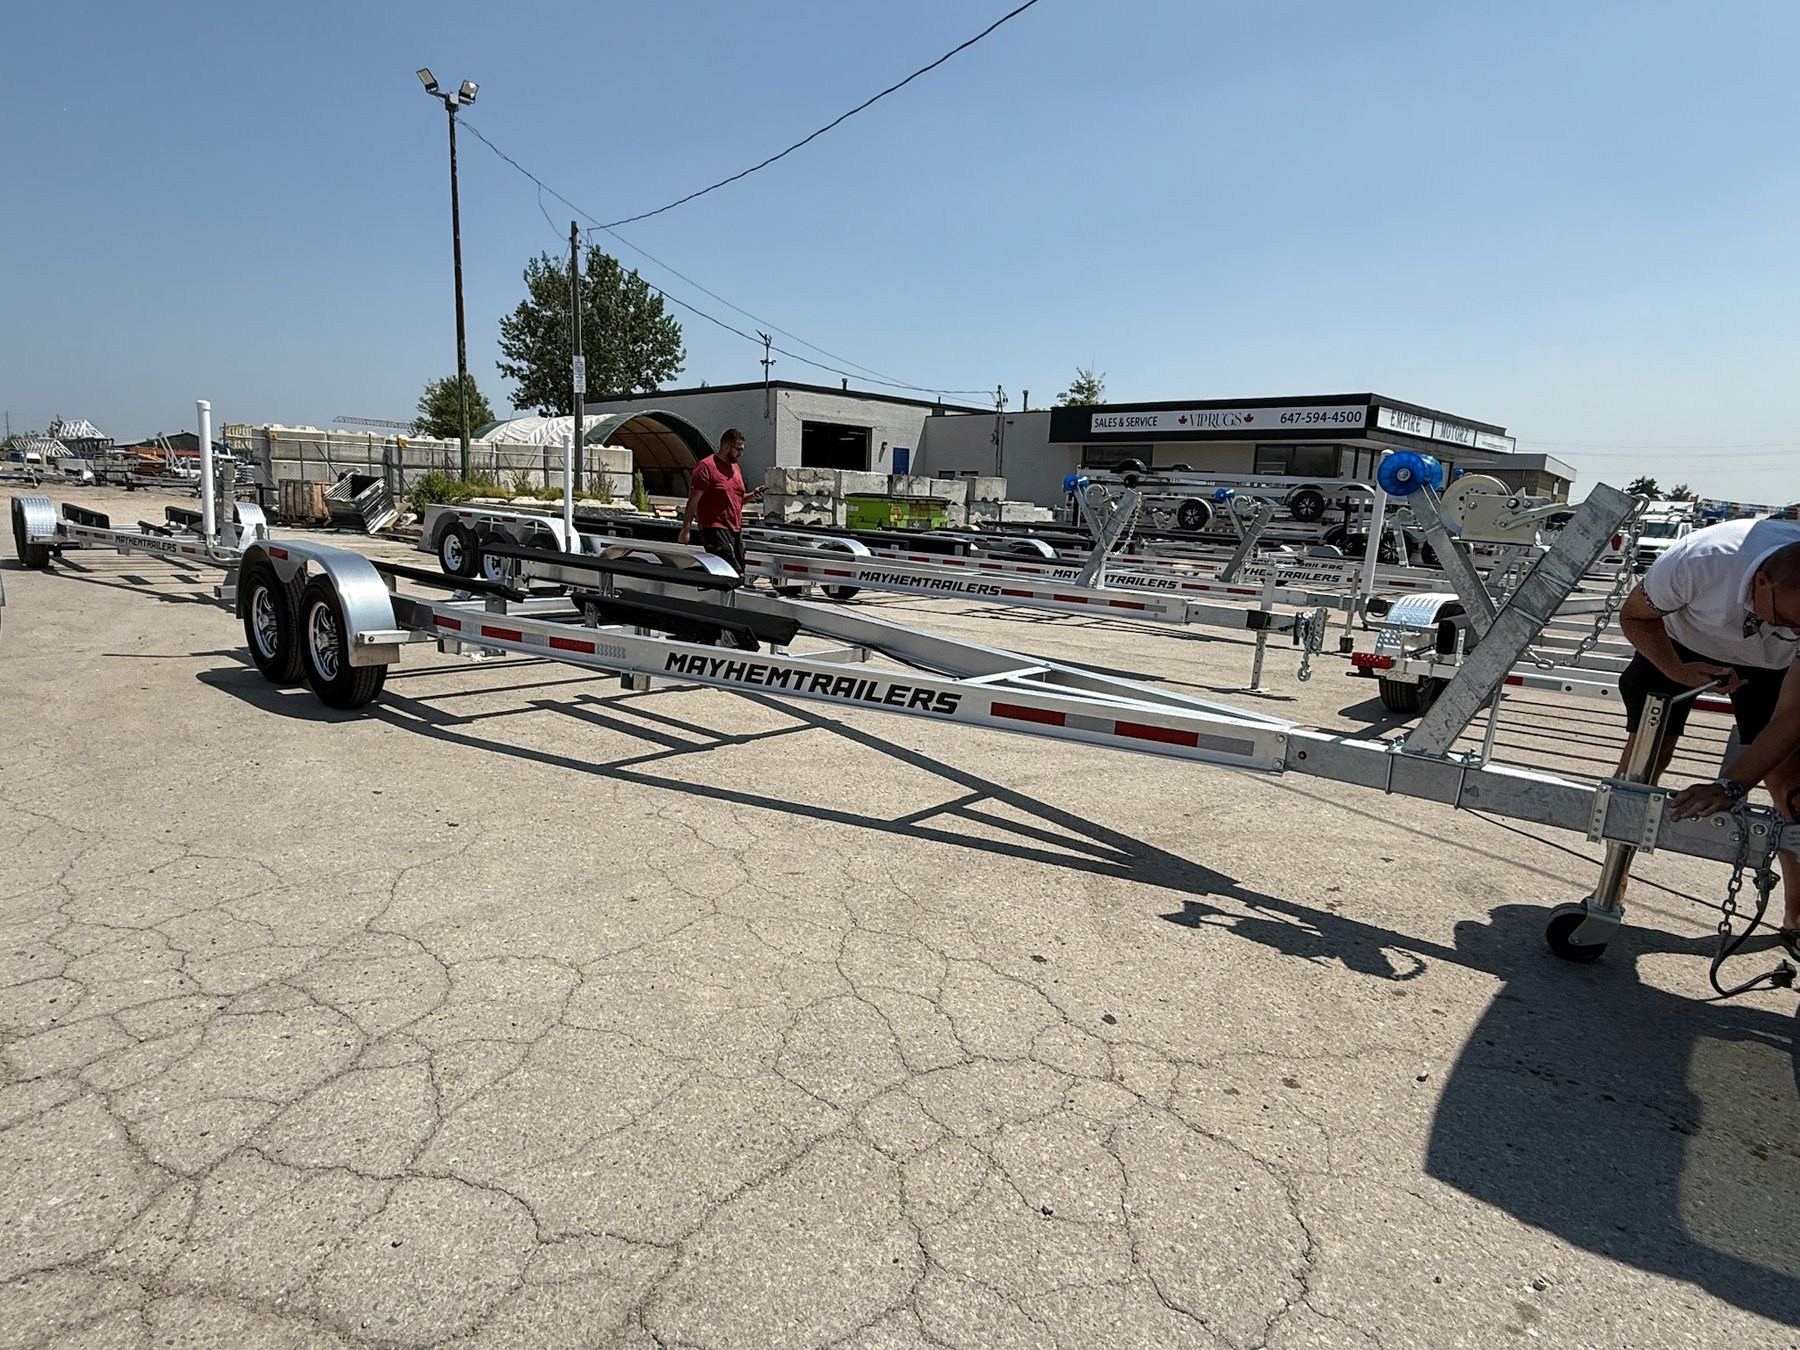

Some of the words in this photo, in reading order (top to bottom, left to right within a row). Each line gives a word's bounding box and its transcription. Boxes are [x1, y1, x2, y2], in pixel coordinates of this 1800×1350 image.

[1094, 417, 1117, 428] SALES
[1119, 417, 1125, 428] &
[1126, 415, 1158, 427] SERVICE
[1280, 411, 1362, 424] 647-594-4500
[1390, 410, 1422, 433] EMPIRE
[1440, 422, 1470, 443] MOTORZ
[115, 534, 177, 553] MAYHEMTRAILERS
[859, 570, 1002, 596] MAYHEMTRAILERS
[664, 652, 963, 715] MAYHEMTRAILERS
